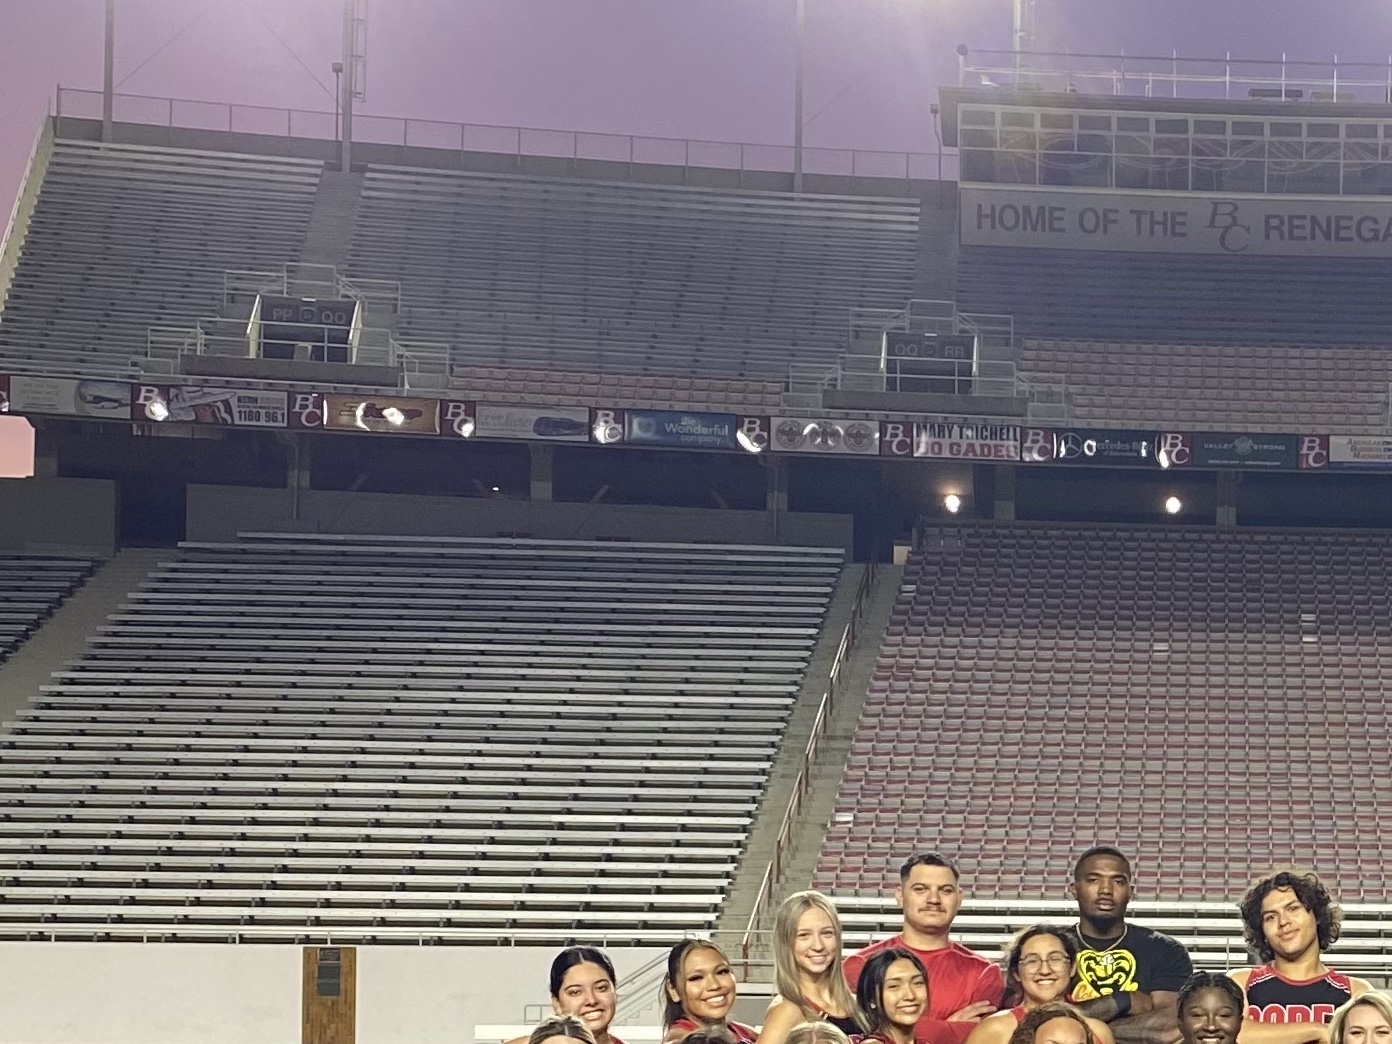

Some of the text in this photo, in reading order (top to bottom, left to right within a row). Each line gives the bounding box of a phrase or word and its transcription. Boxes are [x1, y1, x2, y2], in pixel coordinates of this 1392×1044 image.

[975, 204, 1067, 234] HOME
[1078, 207, 1119, 235] OF
[1129, 209, 1188, 238] THE
[238, 410, 261, 422] 1180
[664, 422, 729, 436] Wonderful
[948, 441, 1018, 458] GADES
